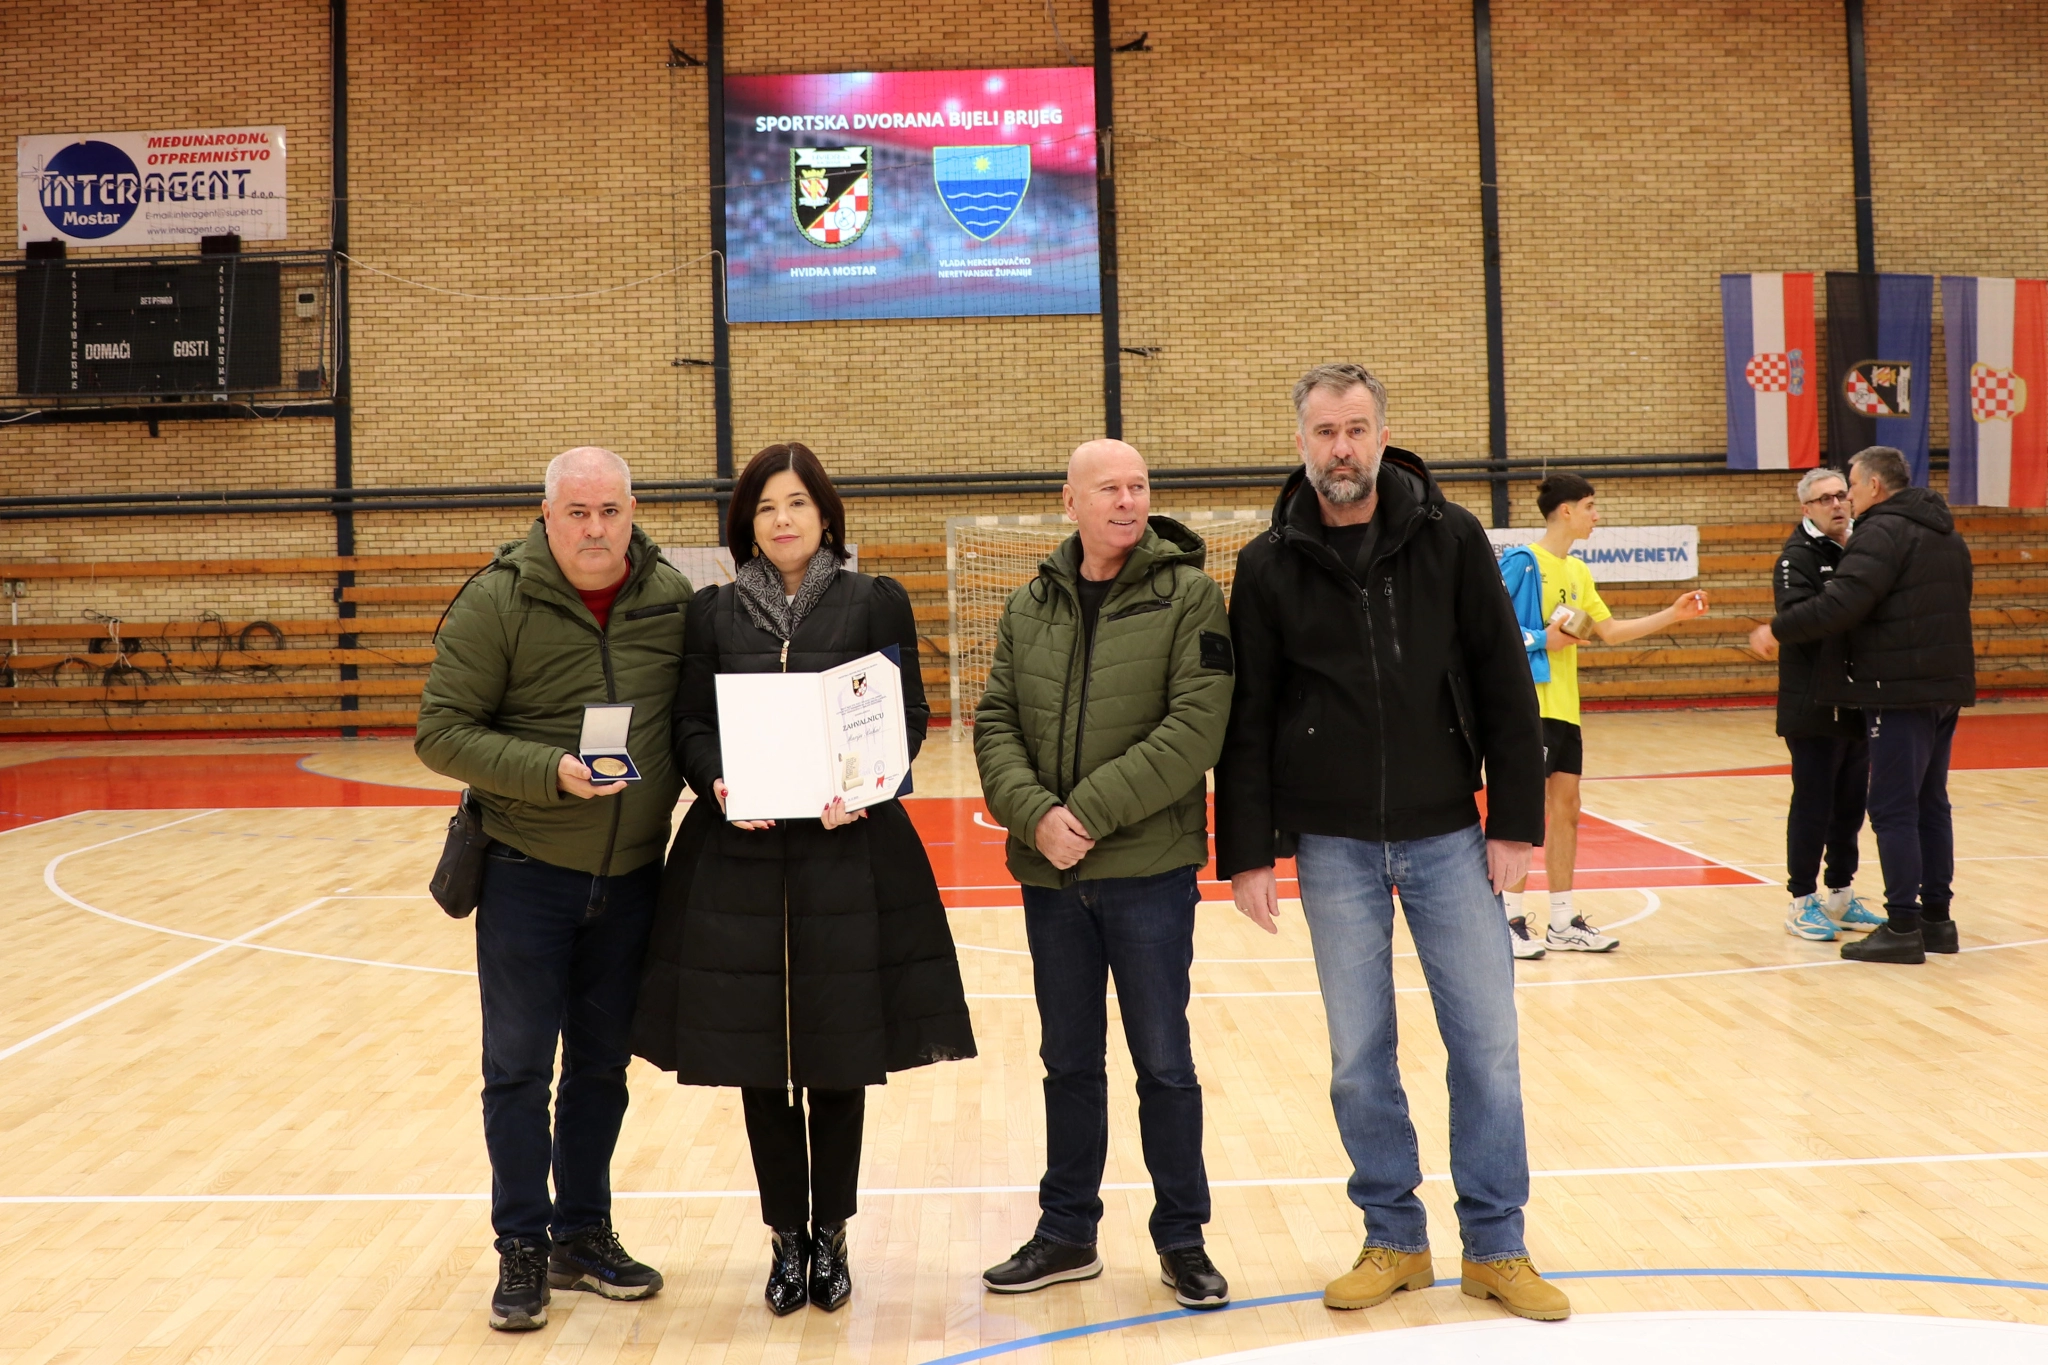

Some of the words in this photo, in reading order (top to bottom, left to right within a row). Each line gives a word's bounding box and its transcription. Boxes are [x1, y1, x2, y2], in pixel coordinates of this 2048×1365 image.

[756, 115, 850, 132] SPORTSKA
[853, 112, 945, 130] DVORANA
[949, 111, 998, 130] BIJELI
[1004, 109, 1063, 129] BRIJEG
[147, 148, 271, 165] OTPREMNIŠTVO
[42, 169, 251, 207] INTERAGENT
[63, 211, 120, 226] Mostar
[939, 259, 966, 267] VLADA
[967, 256, 1031, 267] HERCEGOVAČKO
[790, 267, 831, 277] HVIDRA
[832, 265, 877, 276] MOSTAR
[938, 269, 994, 278] NERETVANSKE
[995, 267, 1032, 277] ŽUPANIJE
[85, 340, 130, 360] DOMAĆI
[173, 340, 209, 357] GOSTI
[1559, 588, 1566, 603] 3
[843, 712, 885, 732] ZAHVALNICU
